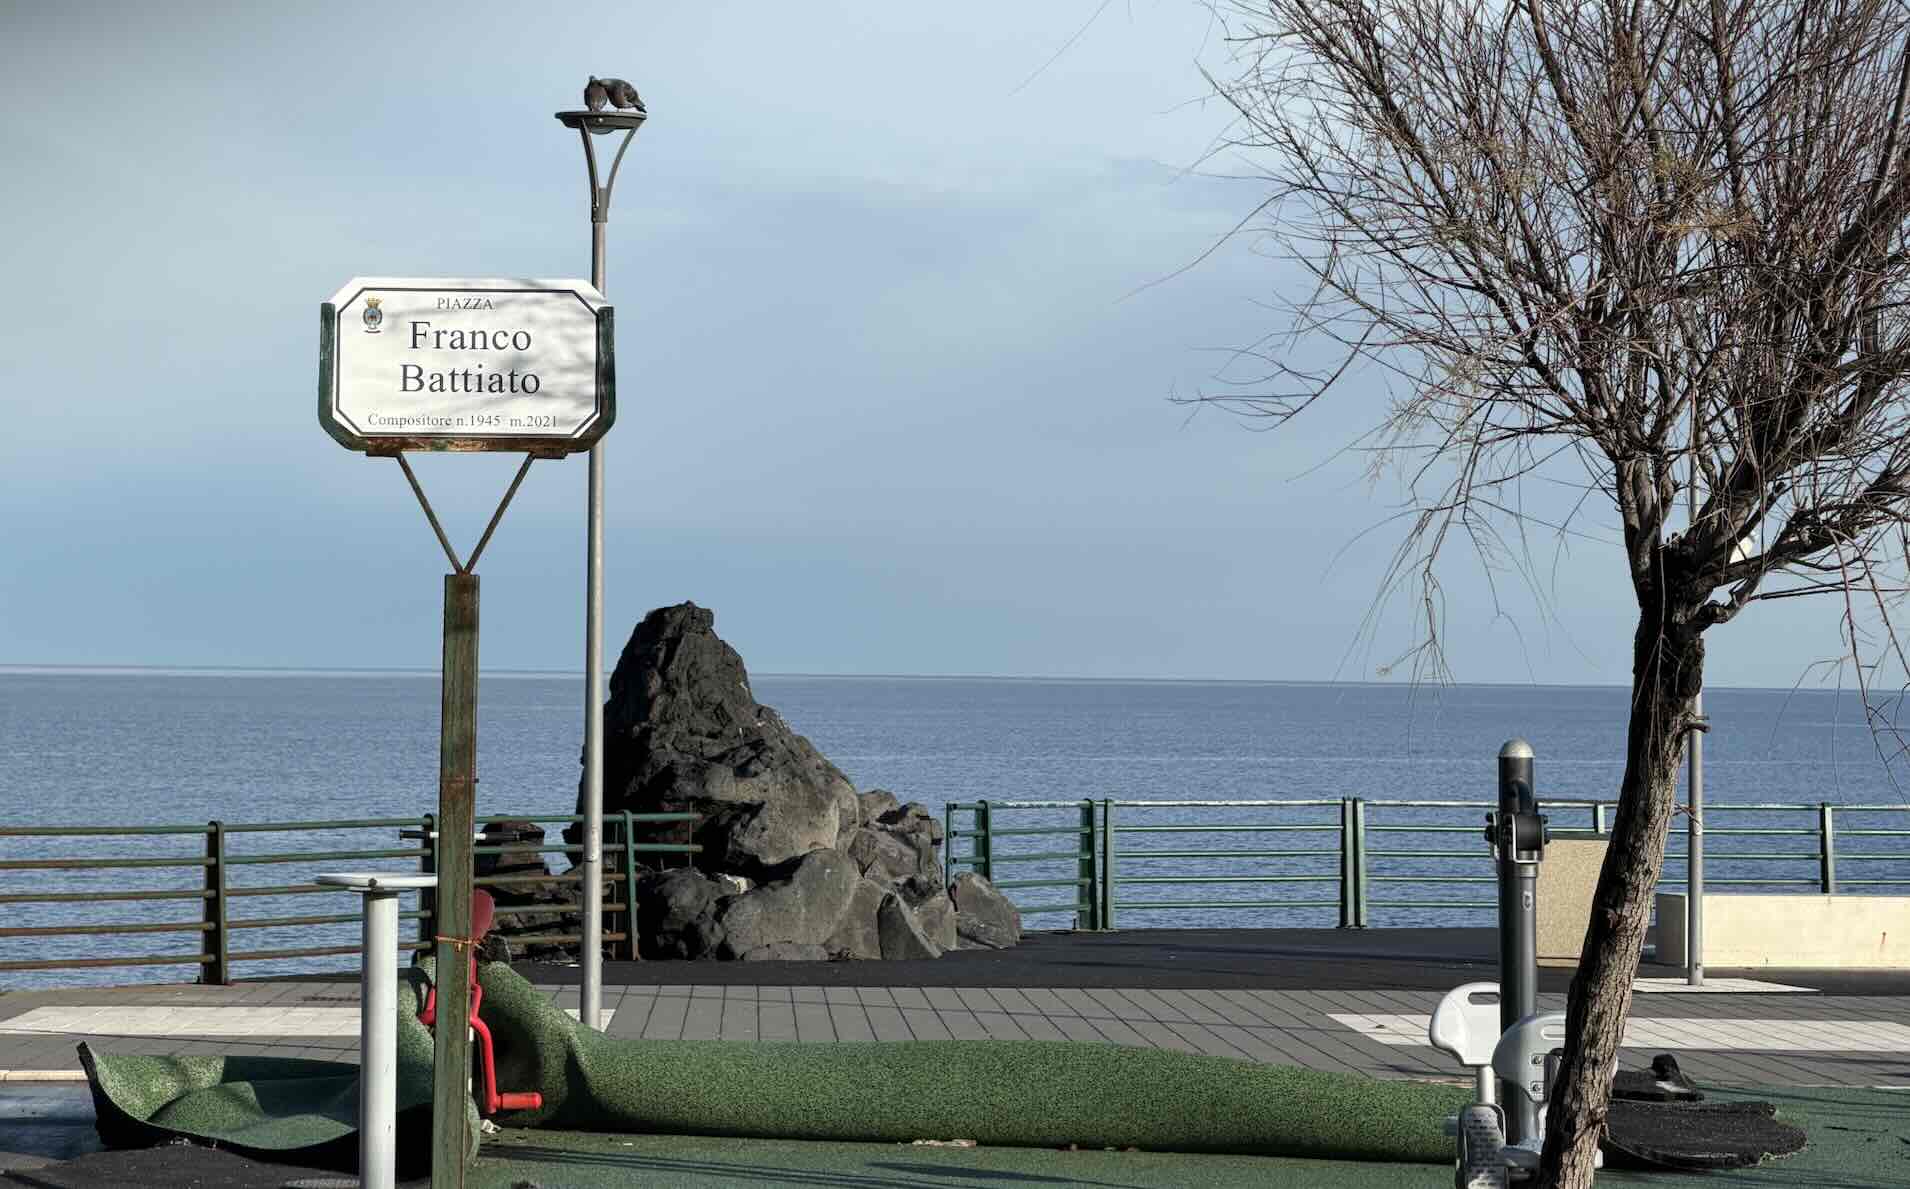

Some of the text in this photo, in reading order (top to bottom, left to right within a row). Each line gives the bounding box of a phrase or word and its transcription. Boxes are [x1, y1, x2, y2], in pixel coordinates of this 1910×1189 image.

[437, 297, 494, 310] PIAZZA
[407, 321, 532, 351] Franco
[400, 364, 540, 394] Battiato
[367, 413, 557, 429] Compositore n.1945 m.2021
